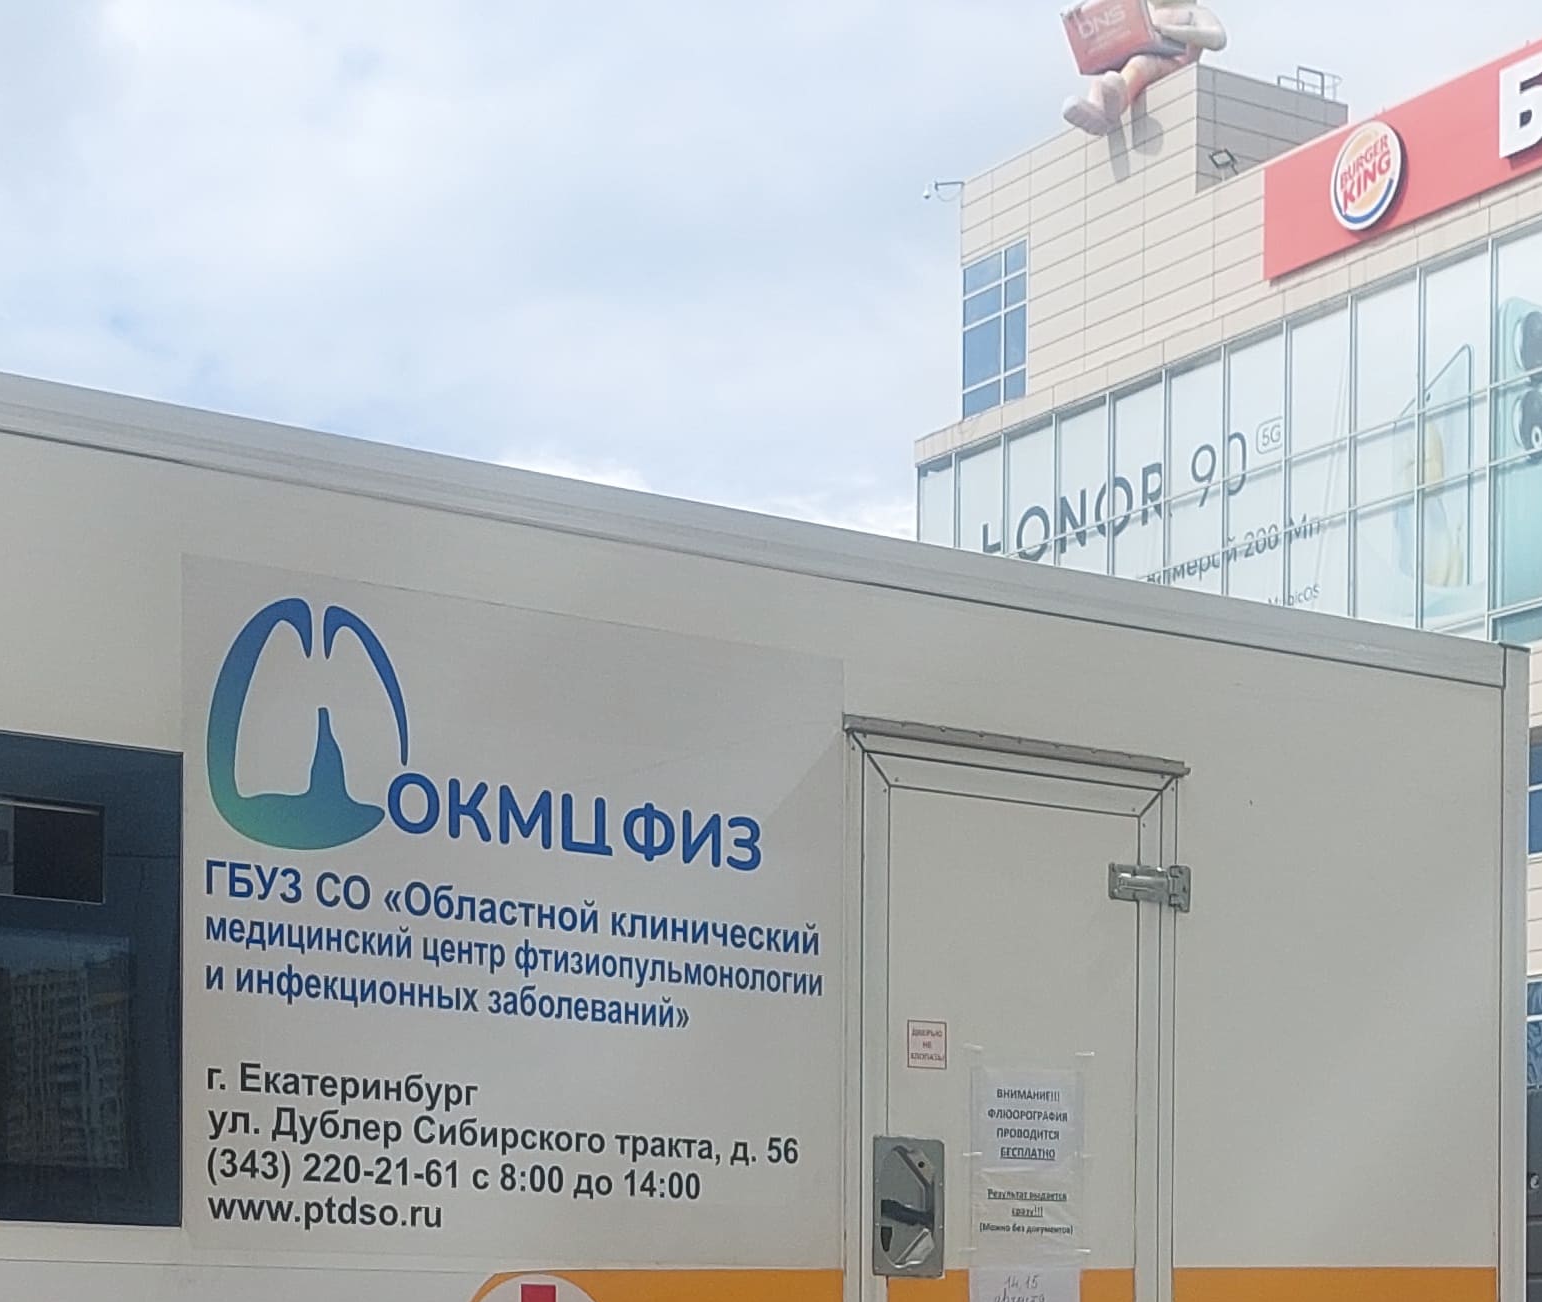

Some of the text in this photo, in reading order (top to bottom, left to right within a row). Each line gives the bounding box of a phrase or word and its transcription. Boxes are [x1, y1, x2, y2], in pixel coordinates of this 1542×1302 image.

[1340, 134, 1388, 189] BURGER
[1343, 150, 1391, 214] KING
[1191, 431, 1247, 507] 90
[1260, 422, 1282, 447] 5G
[1244, 524, 1279, 559] 200
[206, 858, 820, 956] ГБУЗ СО «Областной клинический
[205, 913, 824, 997] медицинский центр фтизиопульмонологии
[206, 963, 690, 1031] и инфекционных заболеваний»
[206, 1063, 479, 1108] г. Екатеринбург
[207, 1106, 799, 1167] ул. Дублер Сибирского тракта, д. 56
[987, 1108, 1068, 1122] ФЛЮОРОГРАФИЯ
[997, 1127, 1060, 1140] ПРОВОДИТСЯ
[206, 1147, 701, 1200] (343) 220-21-61 с 8:00 до 14:00
[1000, 1147, 1056, 1159] БЕСПЛАТНО
[207, 1193, 443, 1231] www.ptdso.ru
